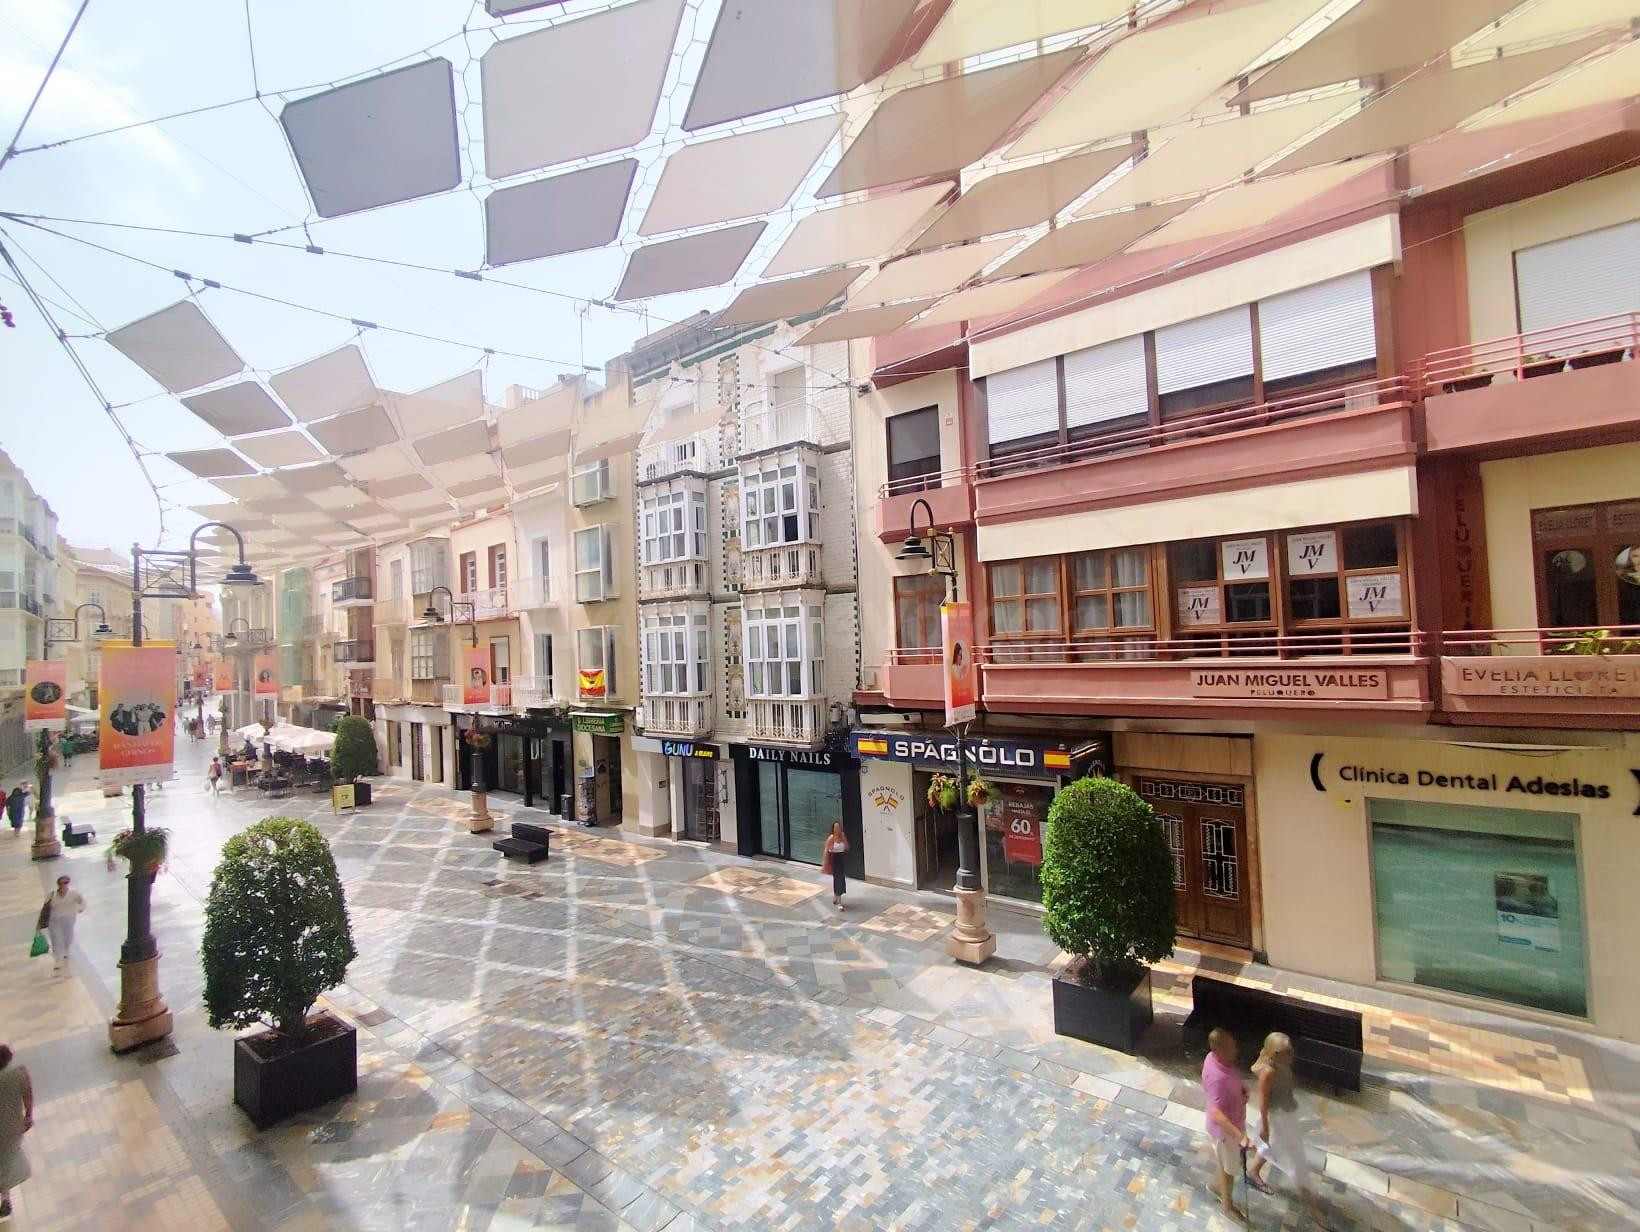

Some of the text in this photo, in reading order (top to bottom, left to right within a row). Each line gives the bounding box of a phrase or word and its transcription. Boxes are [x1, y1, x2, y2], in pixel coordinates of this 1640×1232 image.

[1232, 550, 1256, 564] JM
[1299, 544, 1325, 559] JM
[1241, 563, 1251, 574] V
[1308, 558, 1319, 570] V
[1359, 586, 1387, 601] JM
[1187, 598, 1209, 610] JM
[1197, 674, 1380, 688] JUAN MIGUEL VALLES
[1462, 668, 1539, 682] EVELIA
[1250, 689, 1316, 697] PELUQUERO
[1500, 685, 1618, 695] ESTETICISTA
[749, 747, 831, 766] DAILY NAILS
[894, 741, 1035, 767] SPAGNOLO
[1338, 765, 1611, 799] Clínica Dental Adeslas
